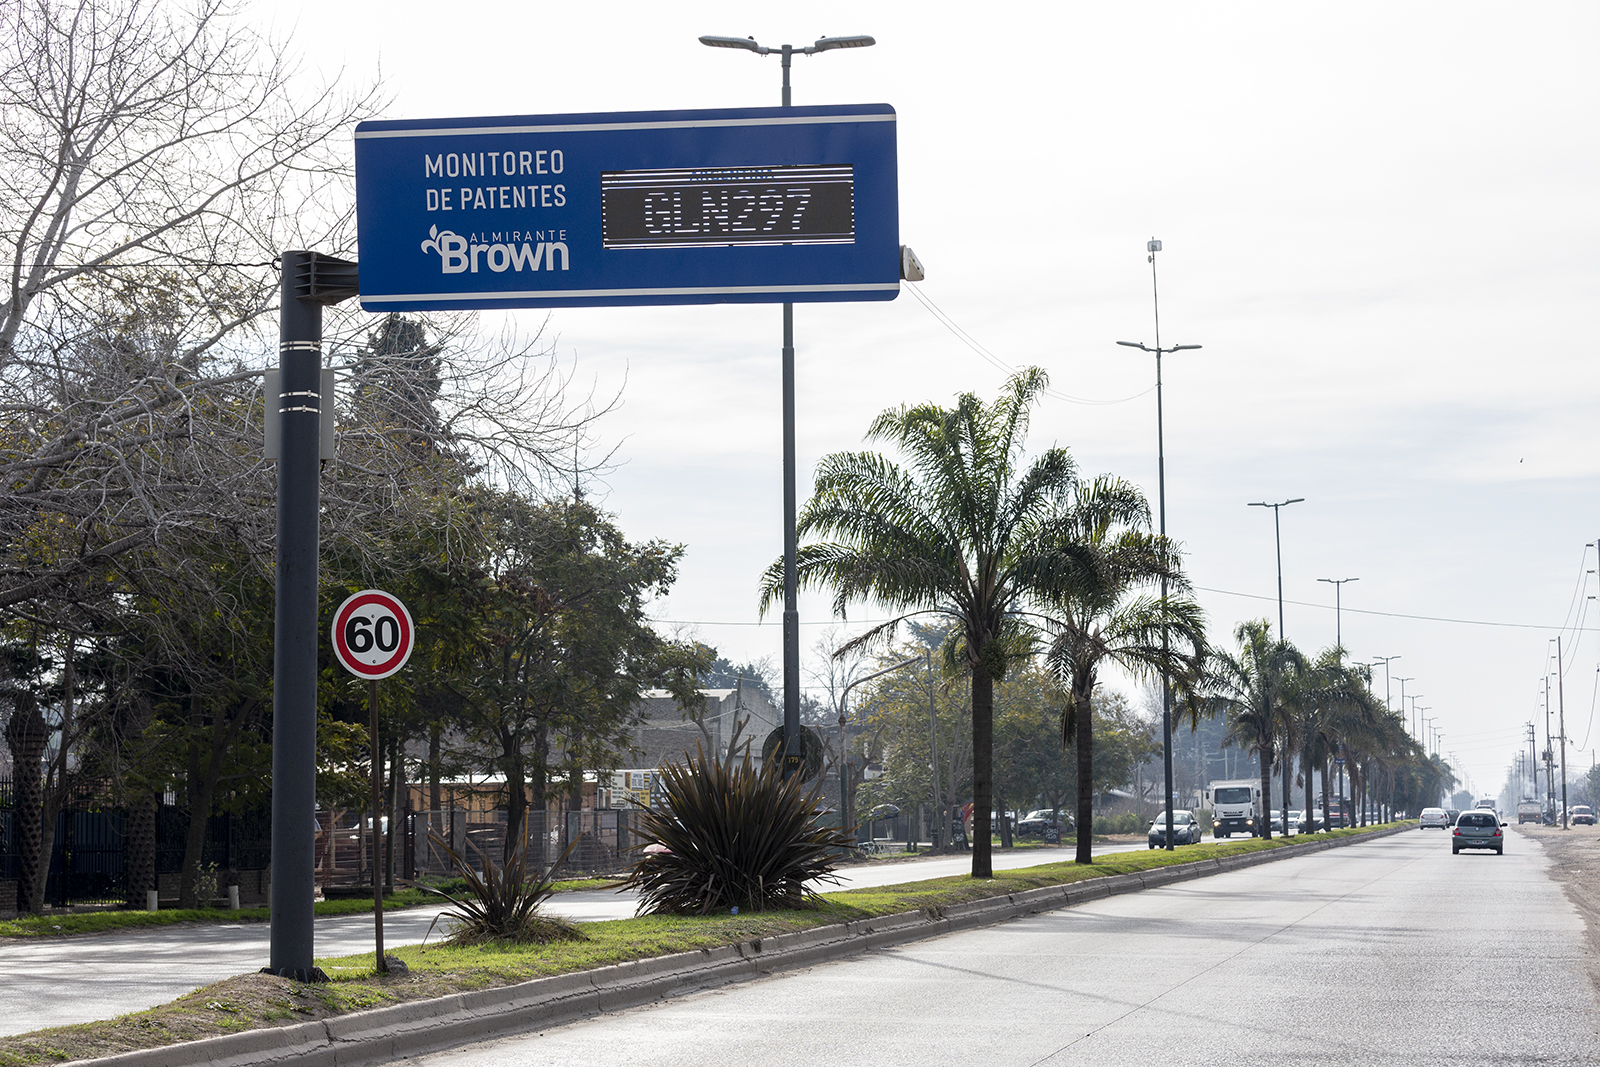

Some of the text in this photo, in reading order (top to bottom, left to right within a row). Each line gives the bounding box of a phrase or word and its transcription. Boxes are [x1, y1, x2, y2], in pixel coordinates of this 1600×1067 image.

[424, 149, 564, 178] MONITOREO
[426, 184, 567, 212] DE PATENTES
[644, 188, 812, 234] GLN297
[469, 229, 568, 243] ALMIRANTE
[441, 234, 570, 274] Brown
[345, 615, 400, 653] 60
